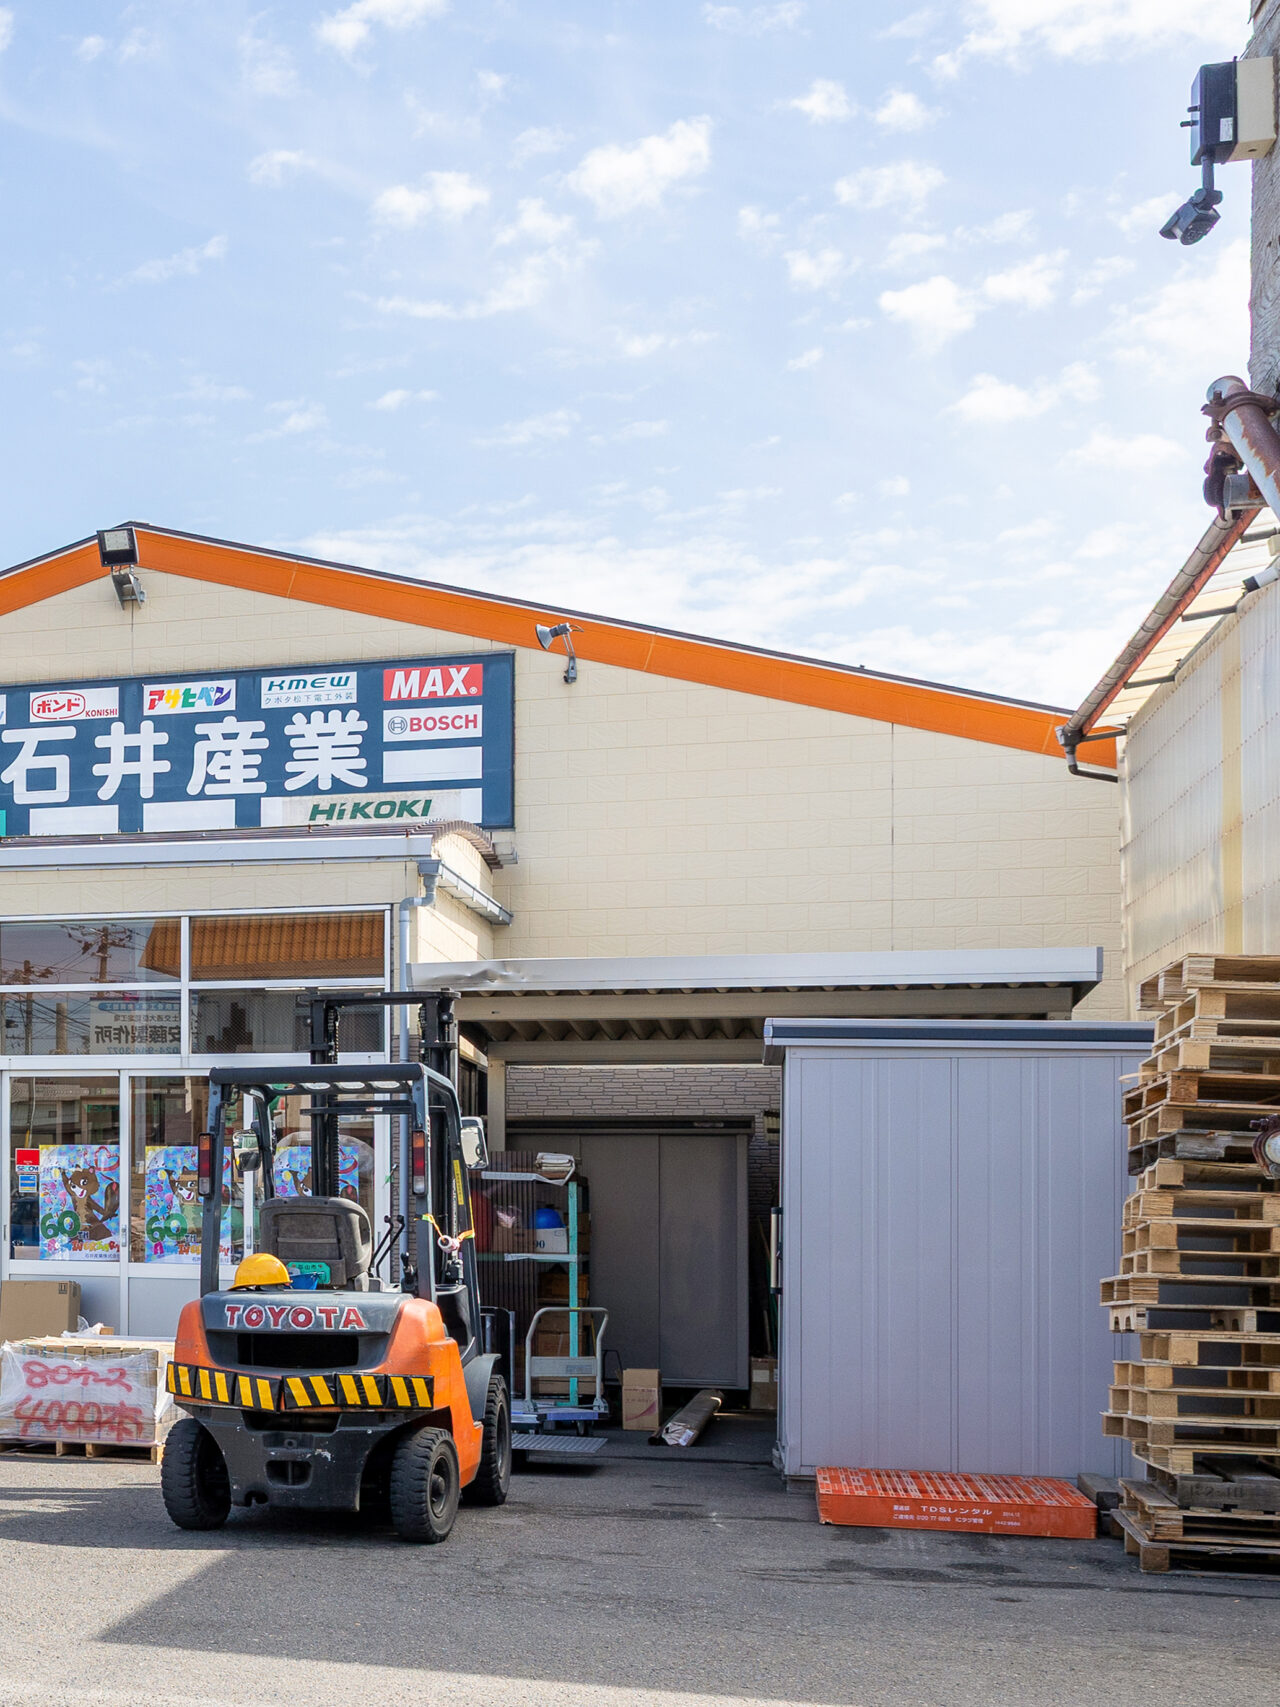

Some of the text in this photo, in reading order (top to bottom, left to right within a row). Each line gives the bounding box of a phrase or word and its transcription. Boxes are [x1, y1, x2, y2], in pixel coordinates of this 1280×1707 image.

[267, 676, 350, 692] KMEW
[390, 667, 470, 699] MAX
[37, 697, 81, 714] ボンド
[148, 686, 232, 711] アサヒペン
[85, 708, 118, 718] KONISHI
[409, 714, 478, 732] BOSCH
[1, 708, 369, 806] 石井産業
[309, 799, 432, 821] HiKOKI
[41, 1210, 80, 1240] 60
[146, 1213, 188, 1243] 60
[225, 1304, 369, 1331] TOYOTA
[920, 1504, 993, 1516] TDSレンタル
